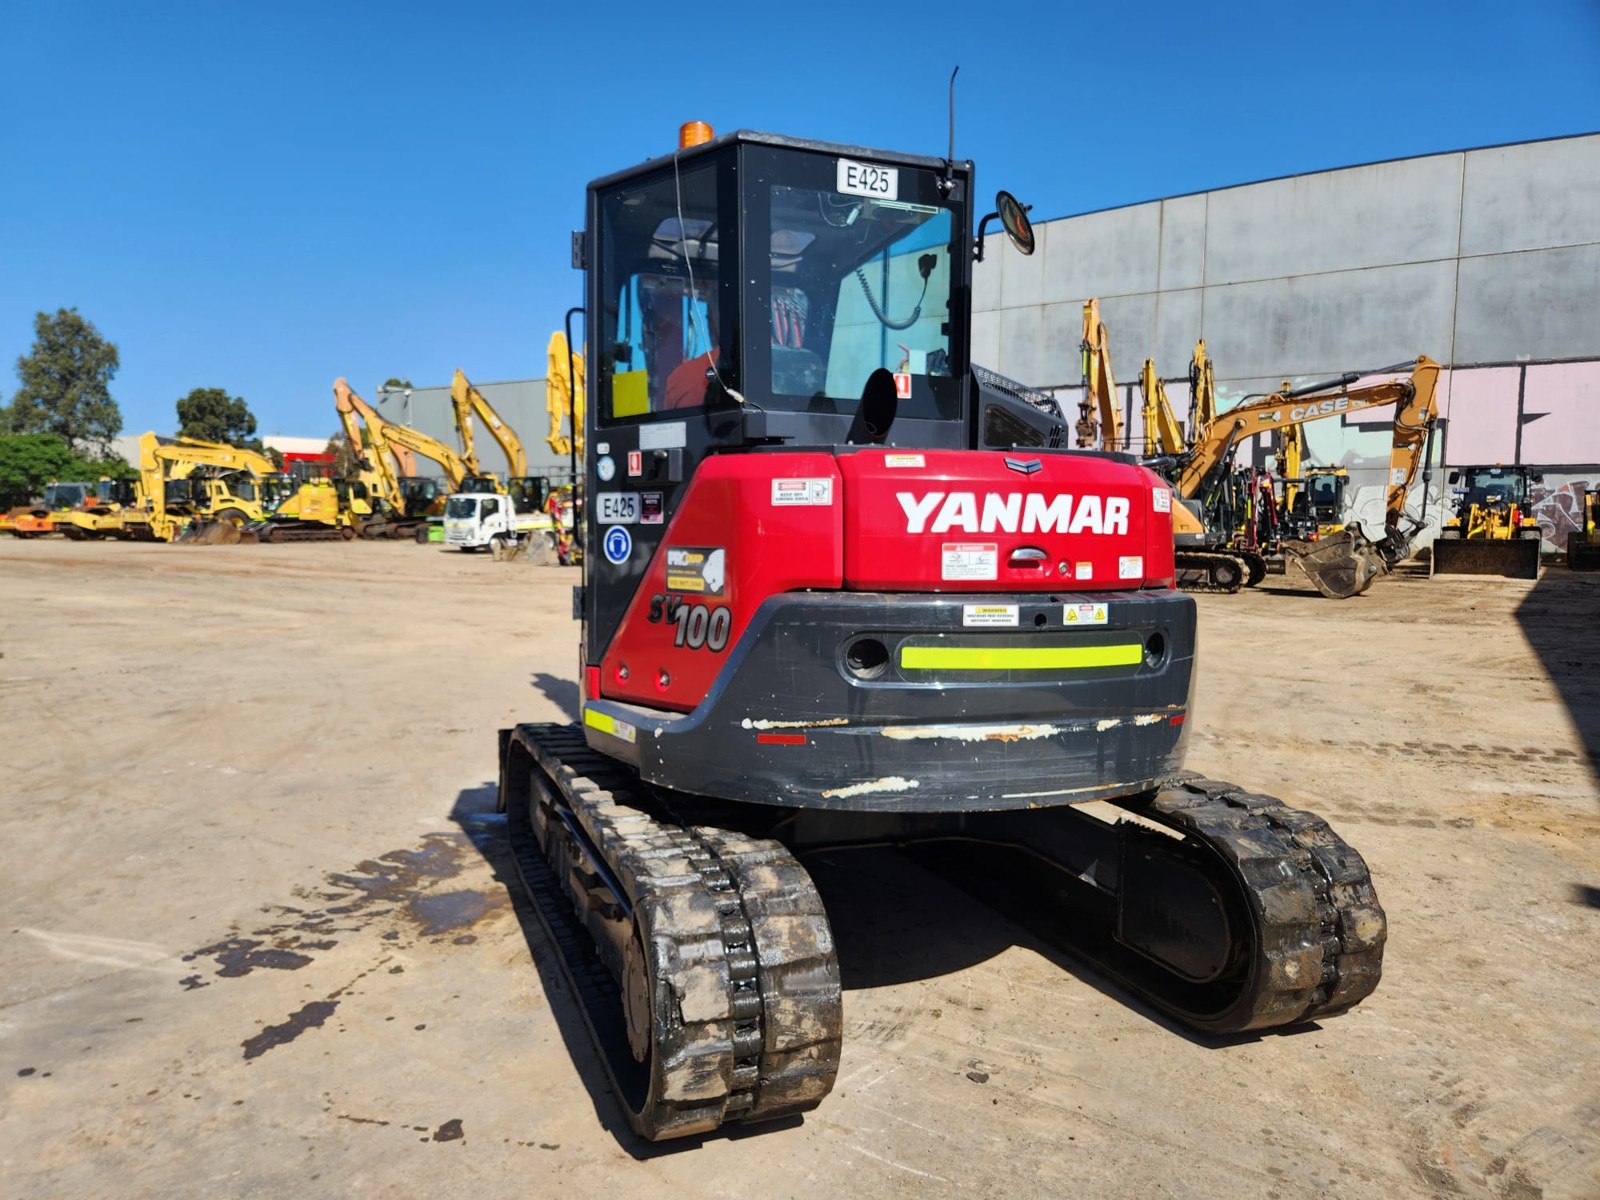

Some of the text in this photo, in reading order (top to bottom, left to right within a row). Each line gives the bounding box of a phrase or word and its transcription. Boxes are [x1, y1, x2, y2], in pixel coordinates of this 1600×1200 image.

[847, 166, 889, 193] E425
[1289, 397, 1349, 420] CASE
[604, 497, 635, 518] E425
[896, 492, 1130, 535] YANMAR
